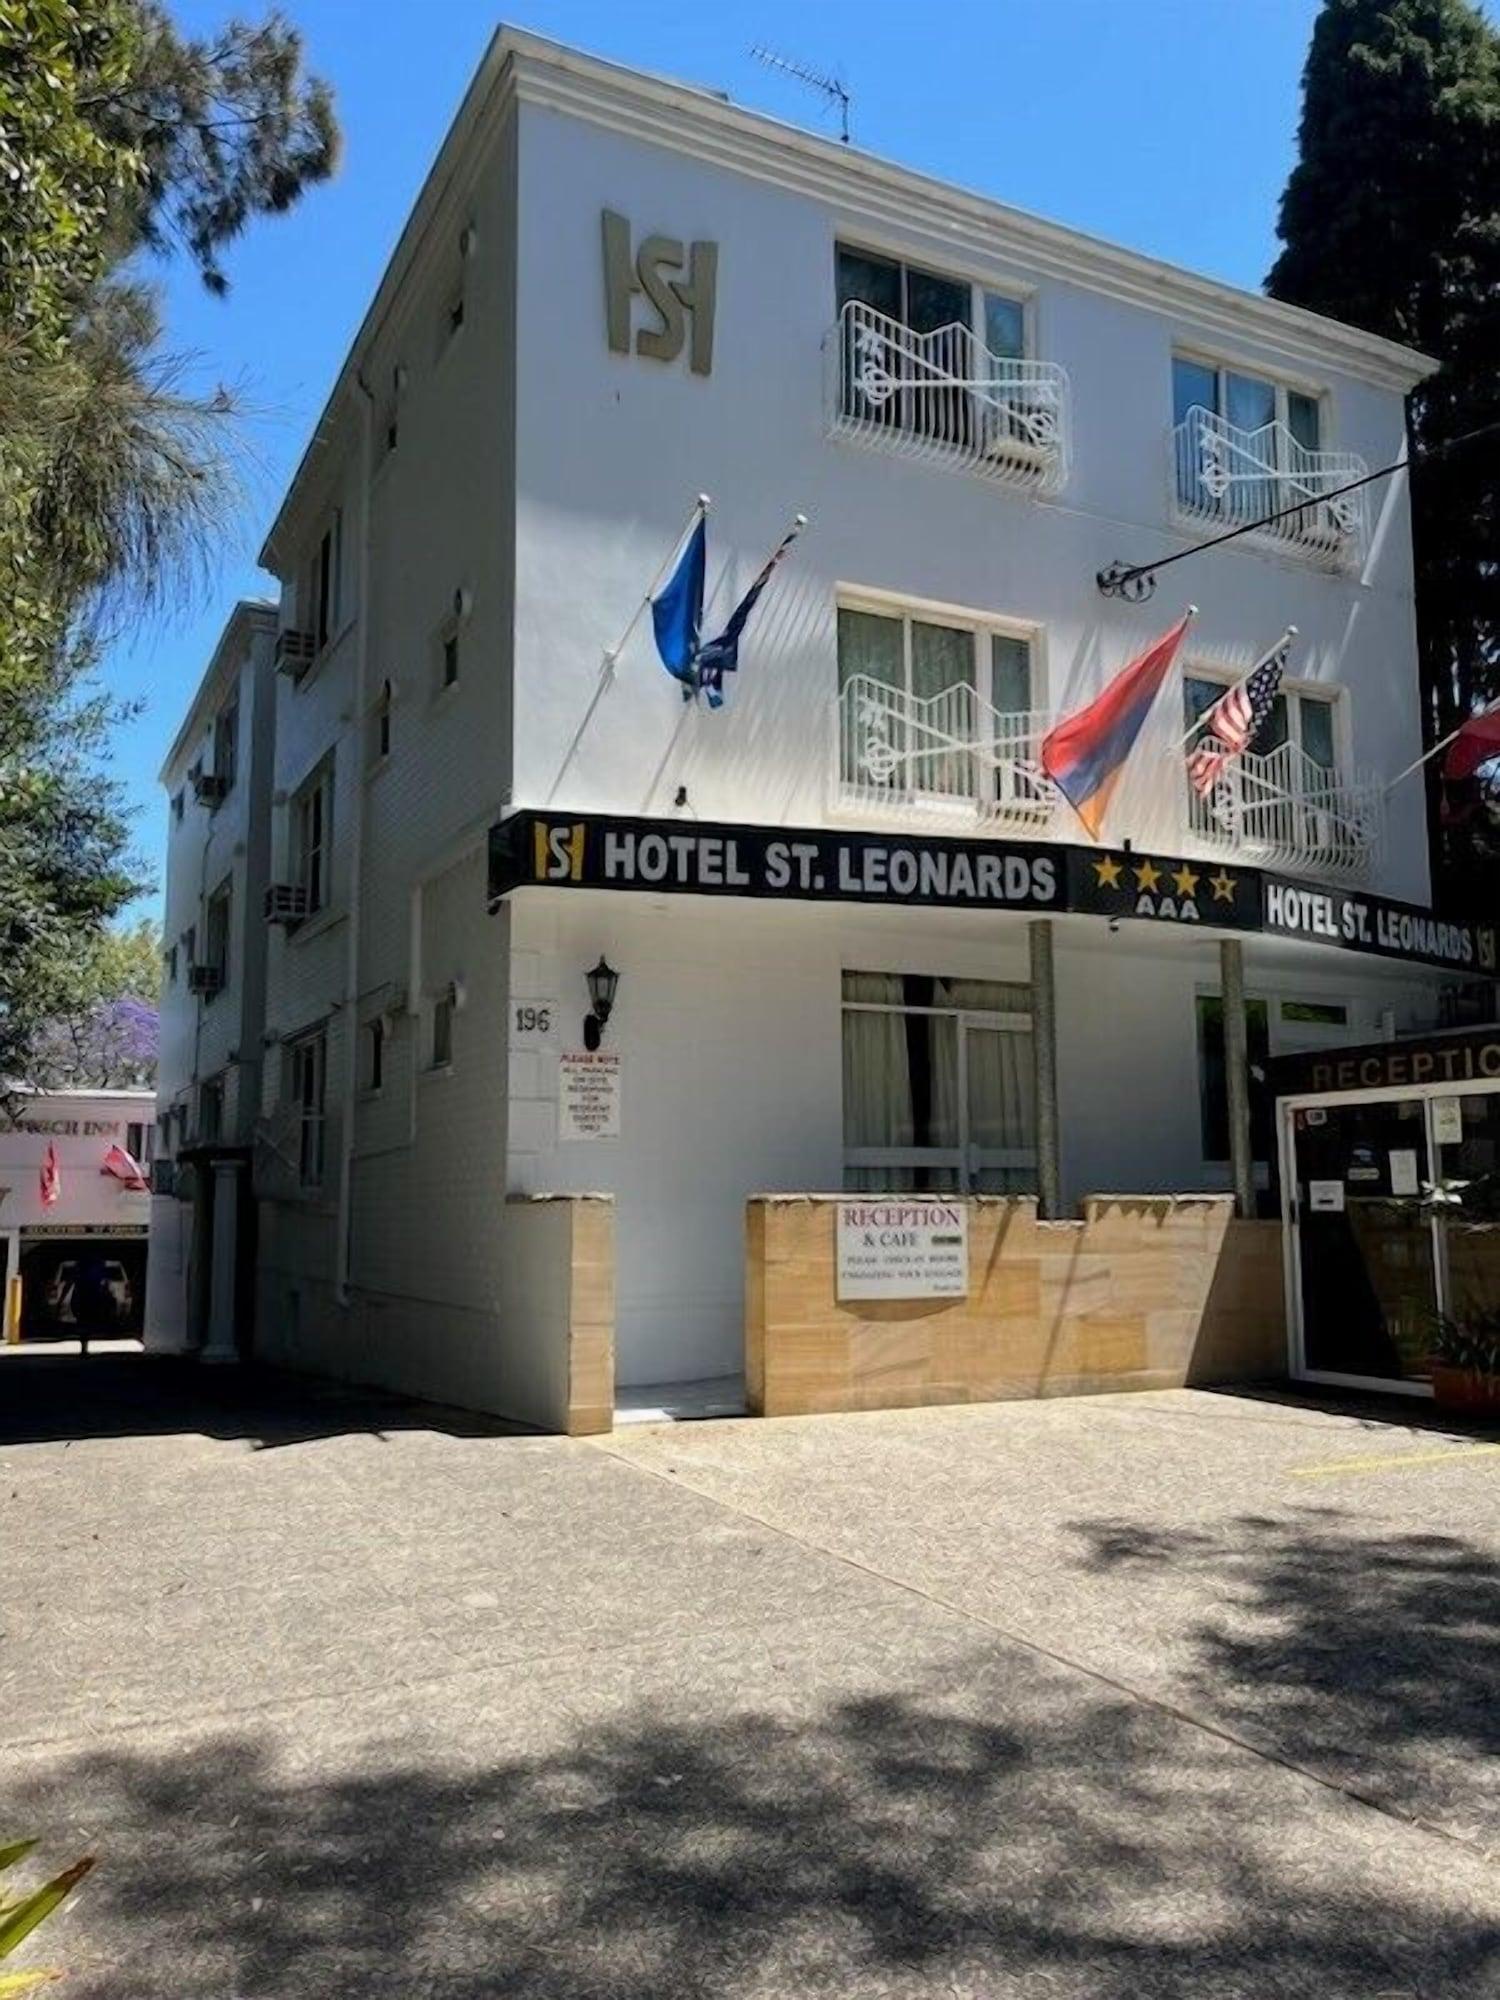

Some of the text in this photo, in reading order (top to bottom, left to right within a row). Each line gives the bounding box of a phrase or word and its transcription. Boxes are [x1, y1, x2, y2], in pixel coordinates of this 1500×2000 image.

[605, 832, 749, 885] HOTEL
[765, 844, 825, 889] ST.
[838, 848, 1056, 900] LEONARDS
[1136, 894, 1200, 920] AAA
[1267, 884, 1338, 937] HOTEL
[1342, 901, 1371, 943] ST.
[1377, 908, 1473, 962] LEONARDS
[516, 1008, 550, 1032] 196
[1312, 1044, 1500, 1091] RECEPTIO
[844, 1207, 960, 1226] RECEPTION
[863, 1232, 875, 1246] &
[880, 1232, 918, 1246] CAFE
